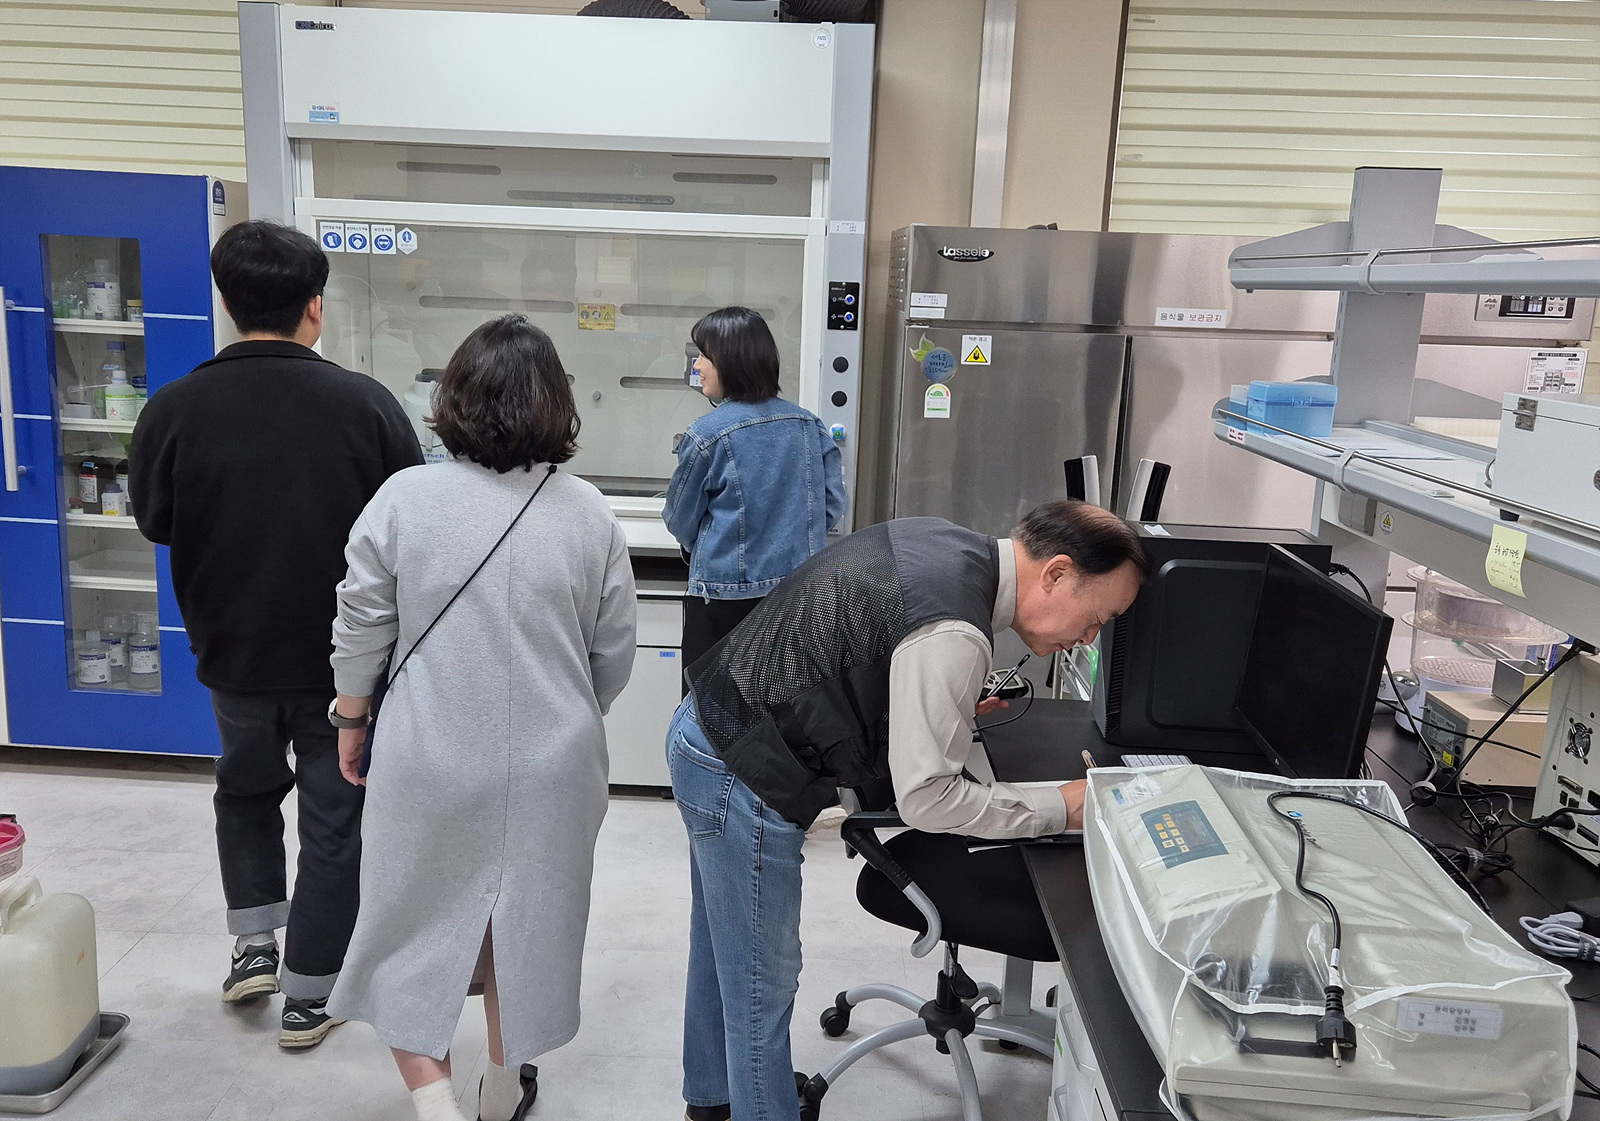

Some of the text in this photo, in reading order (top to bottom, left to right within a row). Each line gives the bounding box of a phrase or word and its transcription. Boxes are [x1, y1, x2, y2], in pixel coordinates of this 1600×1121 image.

[943, 246, 990, 257] Lassele
[1160, 312, 1222, 323] 음식물 보관금지
